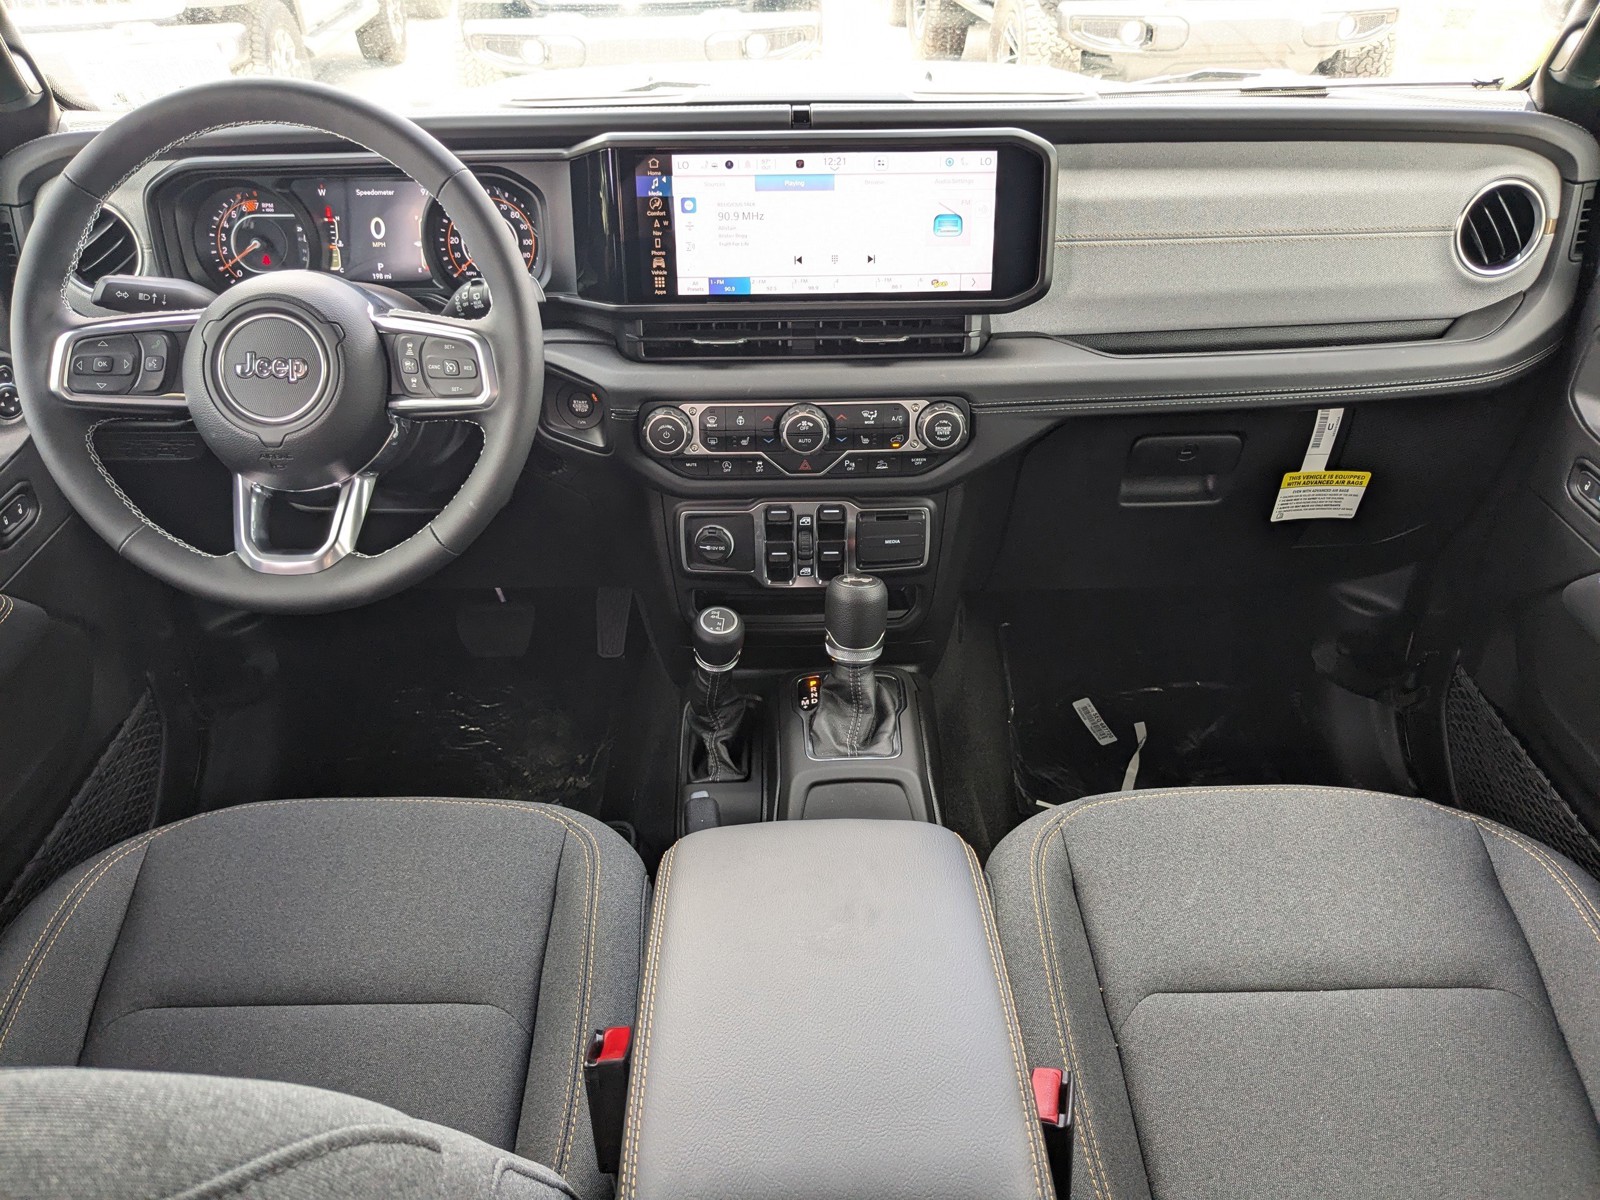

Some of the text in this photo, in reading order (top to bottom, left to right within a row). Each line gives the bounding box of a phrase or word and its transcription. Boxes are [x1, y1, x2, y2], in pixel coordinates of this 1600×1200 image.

[677, 161, 690, 170] LO
[823, 157, 847, 166] 12:21
[980, 157, 992, 166] LO
[784, 179, 806, 188] Playing
[317, 188, 327, 197] W
[355, 188, 395, 197] Speedometer
[717, 211, 765, 221] 90.9 MHz
[370, 216, 386, 239] 0
[221, 233, 226, 241] 3
[450, 236, 459, 244] 20
[522, 238, 533, 246] 100
[222, 247, 228, 255] 2
[377, 262, 384, 271] P
[237, 269, 243, 277] 0
[372, 272, 382, 280] 198
[235, 350, 309, 384] Jeep
